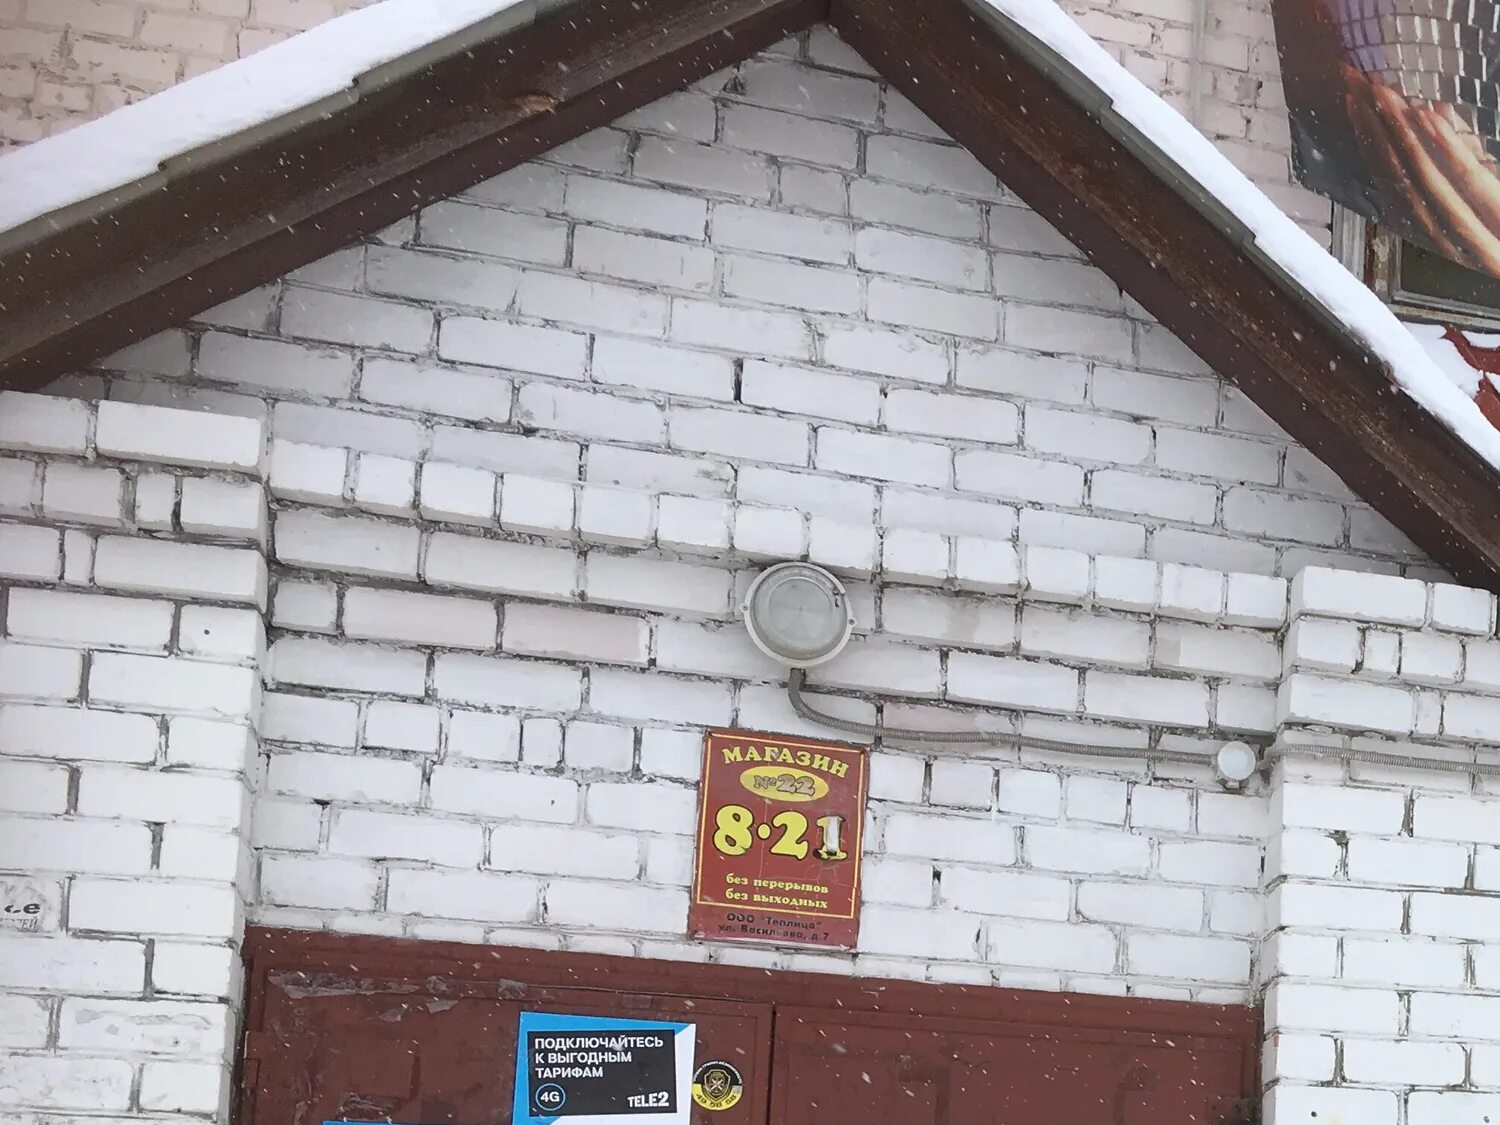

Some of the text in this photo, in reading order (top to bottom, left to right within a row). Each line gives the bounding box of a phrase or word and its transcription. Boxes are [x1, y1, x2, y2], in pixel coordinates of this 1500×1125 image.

[722, 745, 850, 779] МАГАЗИН
[753, 774, 815, 797] №22
[725, 872, 830, 895] без перерывов
[725, 888, 829, 909] без выходных
[726, 912, 756, 924] ООО
[534, 1035, 664, 1051] ПОДКЛЮЧАЙТЕСЬ
[535, 1051, 632, 1065] К ВЫГОДНЫМ
[535, 1066, 604, 1079] ТАРИФАМ
[540, 1091, 560, 1103] 4G
[627, 1091, 670, 1108] TELE2
